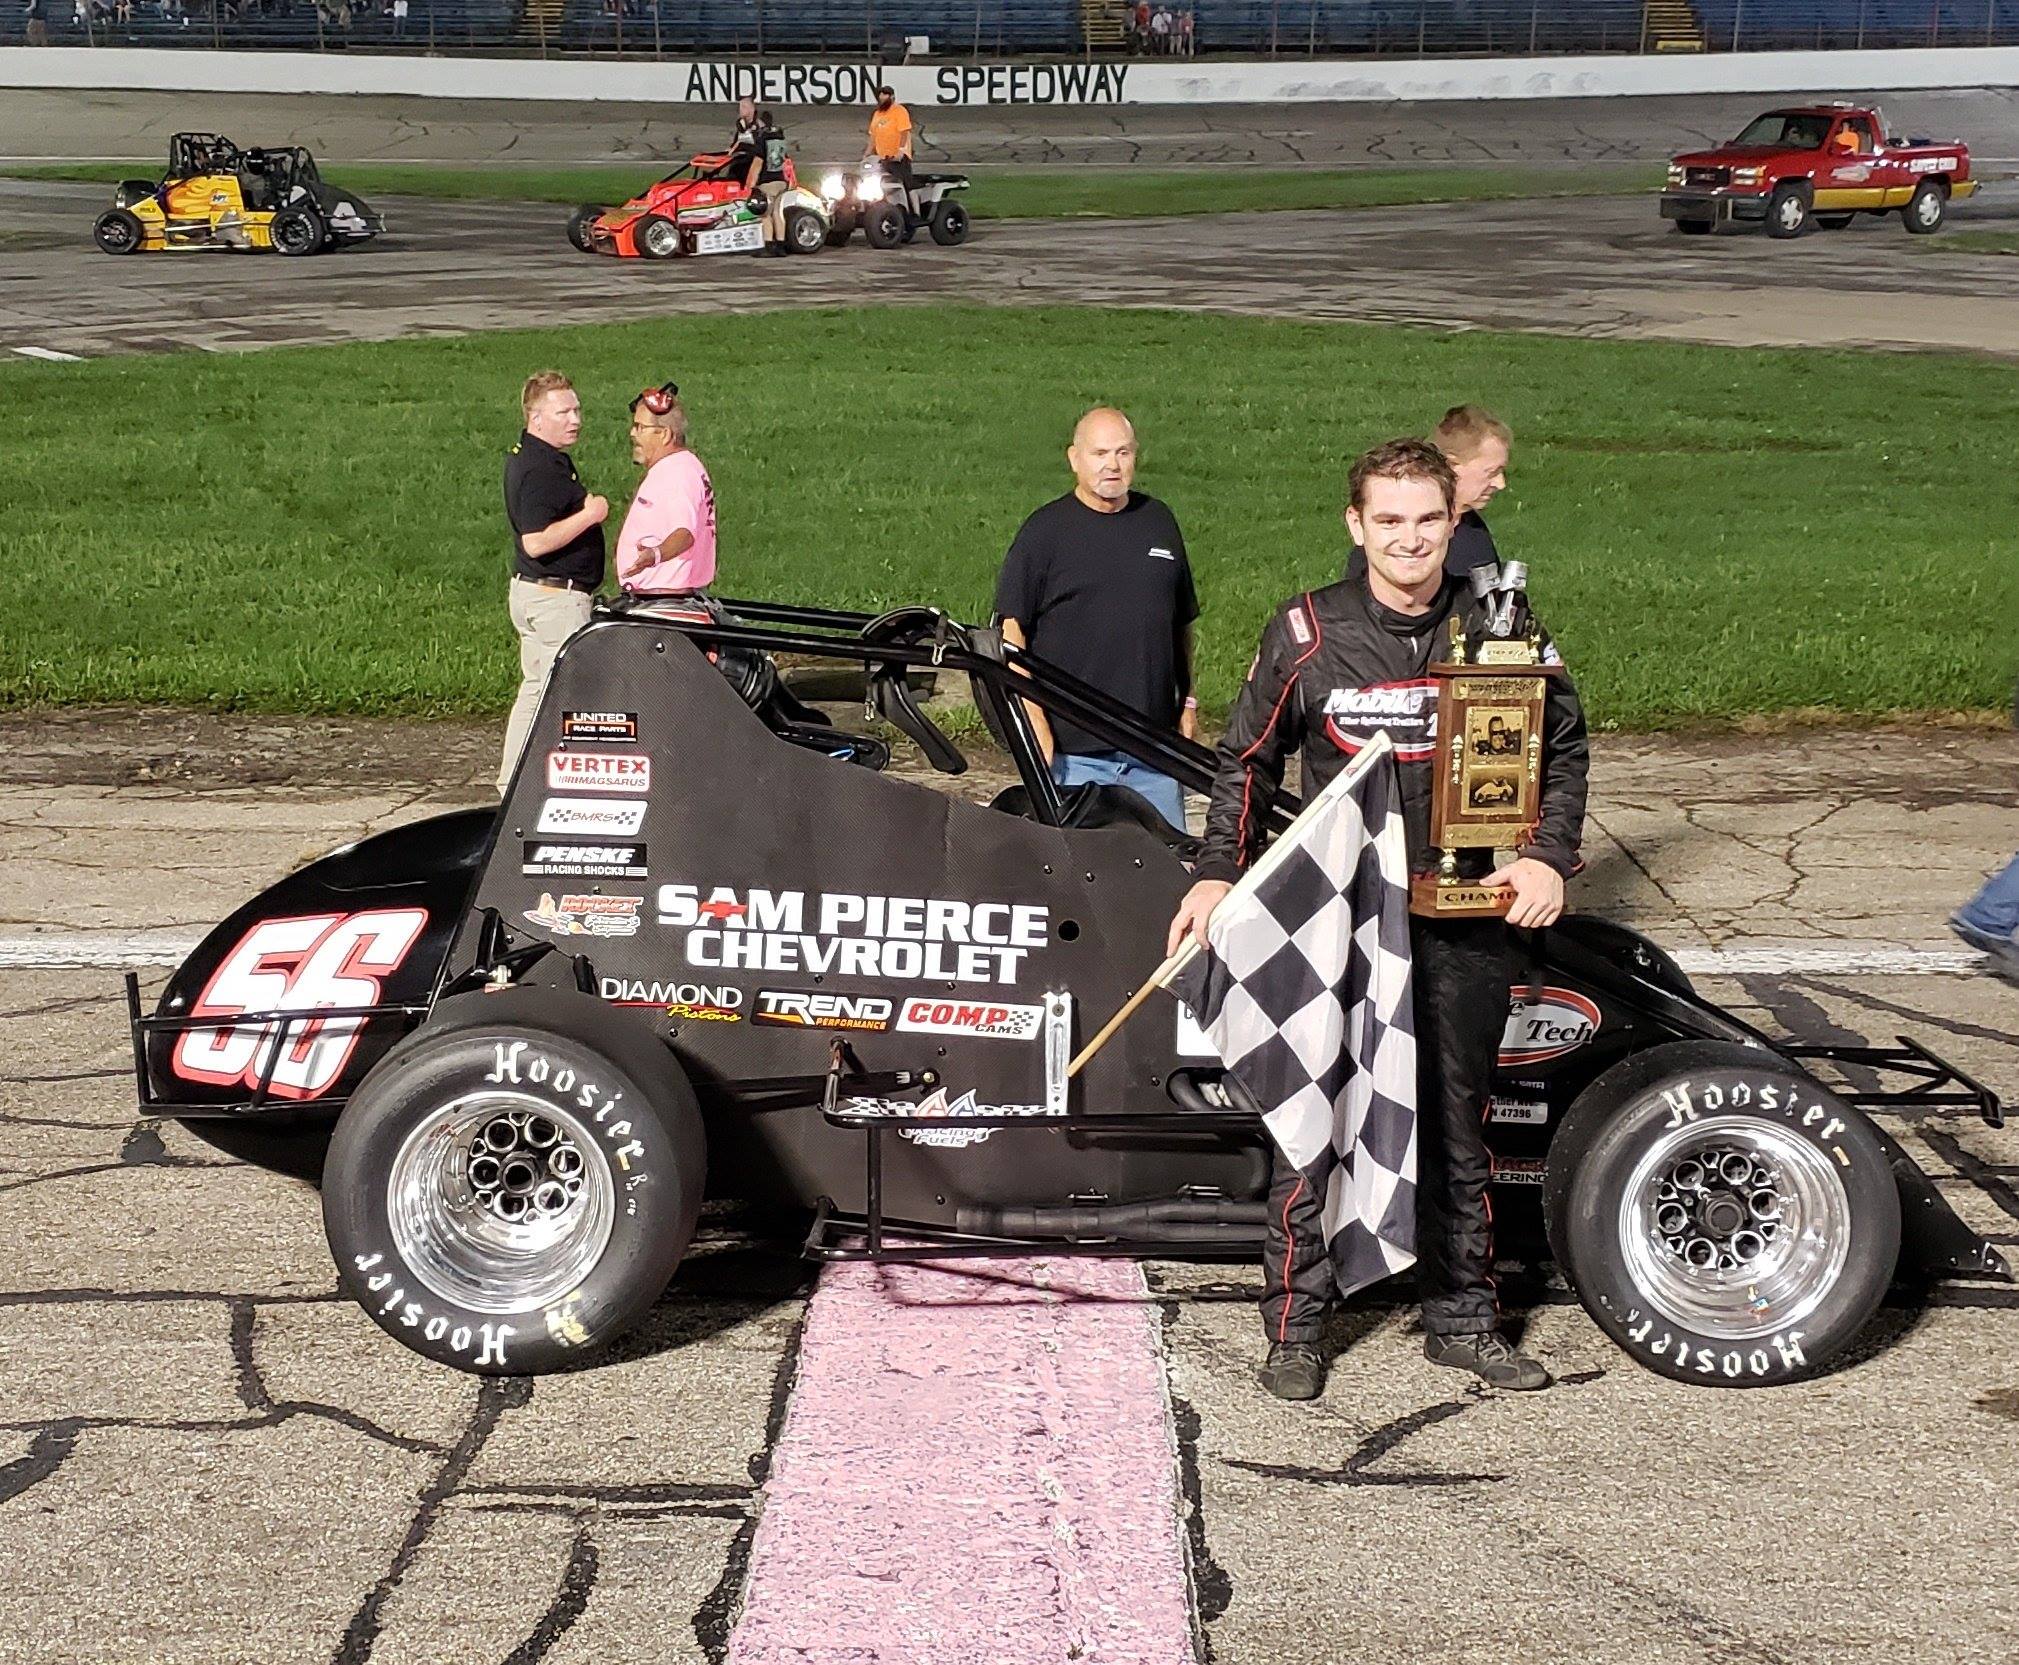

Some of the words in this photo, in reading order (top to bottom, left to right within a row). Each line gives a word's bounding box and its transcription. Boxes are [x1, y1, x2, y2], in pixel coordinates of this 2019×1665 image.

[686, 63, 883, 105] ANDERSON
[936, 63, 1129, 104] SPEEDWAY
[1322, 688, 1424, 714] Mobile
[572, 712, 627, 723] UNITED
[553, 756, 646, 774] VERTEX
[570, 812, 615, 822] BMRS
[533, 846, 636, 864] PENSKE
[544, 864, 582, 875] RACING
[584, 865, 625, 876] SHOCKS
[657, 884, 805, 931] SAM
[819, 892, 1050, 947] PIERCE
[686, 929, 1029, 984] CHEVROLET
[172, 908, 429, 1100] 56
[601, 977, 743, 1009] DIAMOND
[666, 1004, 742, 1023] Pistons
[759, 991, 893, 1025] TREND
[907, 1002, 1009, 1026] COMP
[815, 1017, 887, 1030] PERFORMANCE
[975, 1023, 1024, 1035] CAMS
[1526, 1019, 1593, 1042] Tech
[484, 1042, 645, 1158] Hoosier
[1660, 1080, 1846, 1139] Hoosier
[917, 1135, 966, 1145] Fuels
[355, 1253, 517, 1366] Hoosier
[1628, 1320, 1807, 1378] Hoosier
